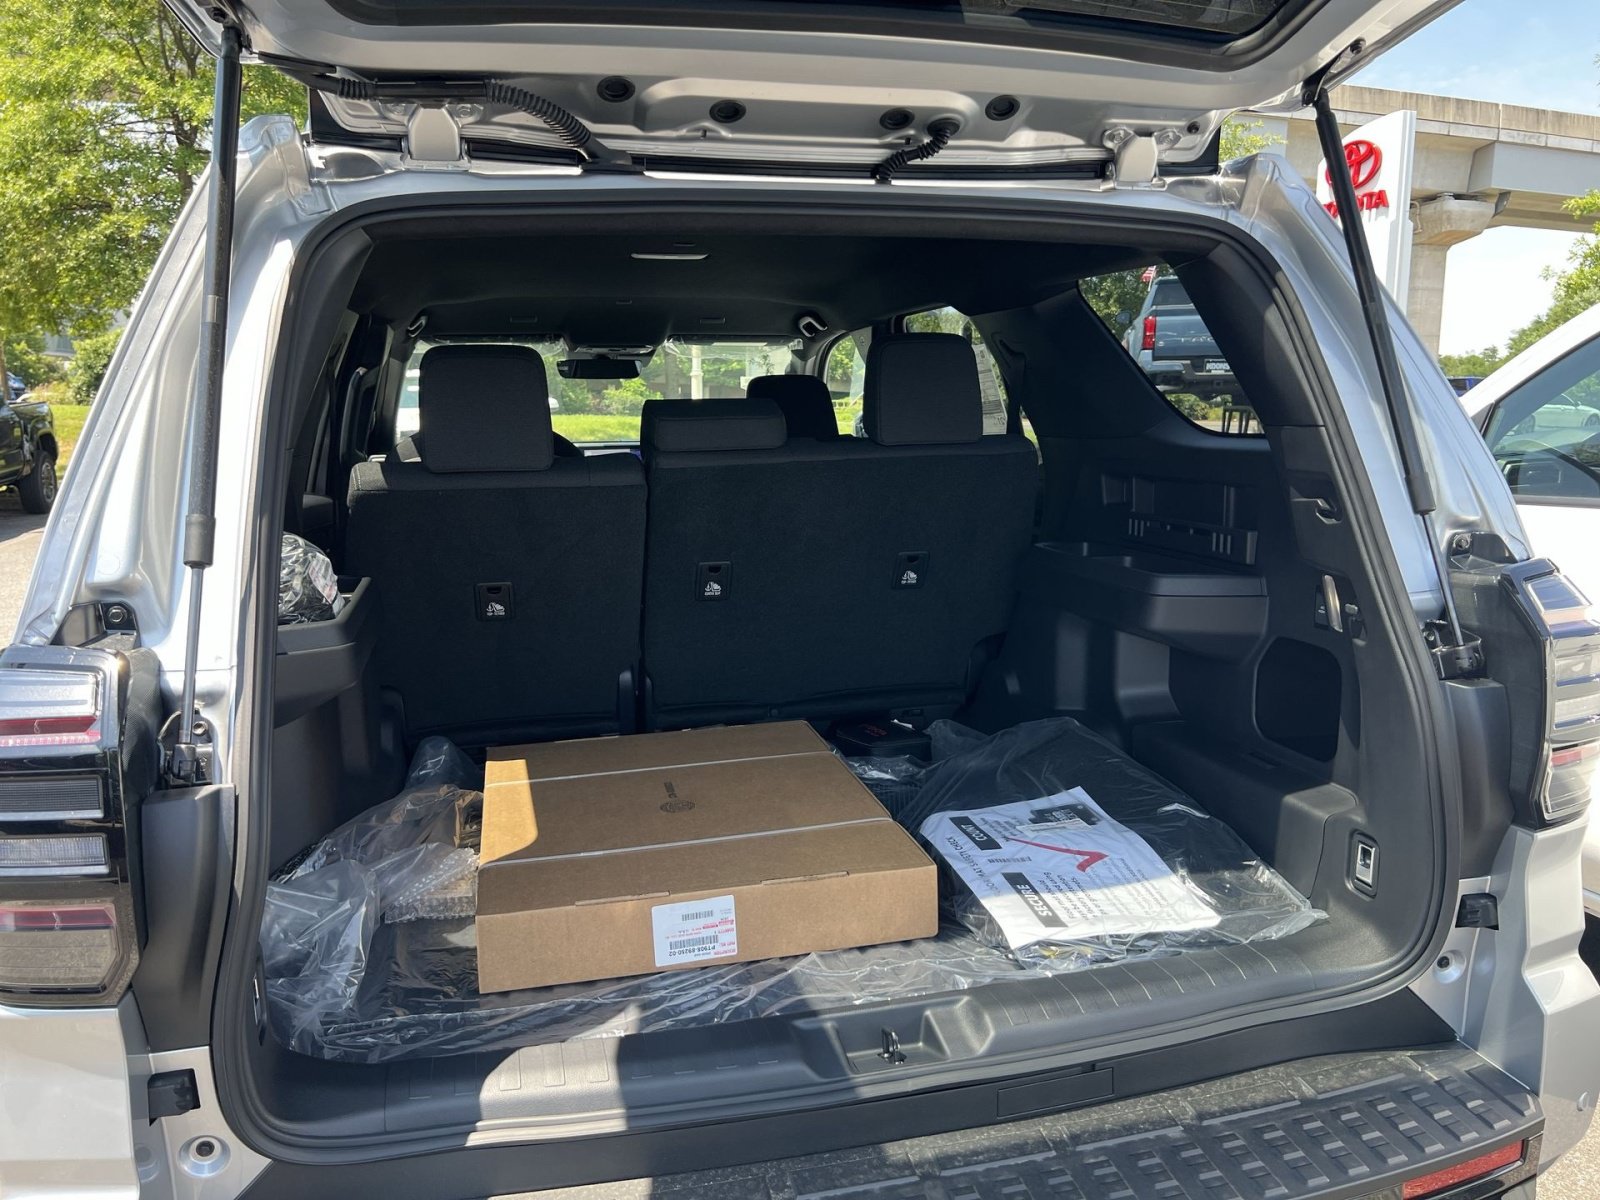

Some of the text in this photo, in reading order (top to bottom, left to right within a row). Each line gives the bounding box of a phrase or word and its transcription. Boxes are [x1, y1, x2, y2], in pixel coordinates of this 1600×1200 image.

[1323, 190, 1389, 218] TOTA
[961, 824, 987, 840] COUNT
[946, 836, 963, 850] CHECK
[960, 851, 978, 867] SAFETY
[1017, 885, 1052, 916] SECURE
